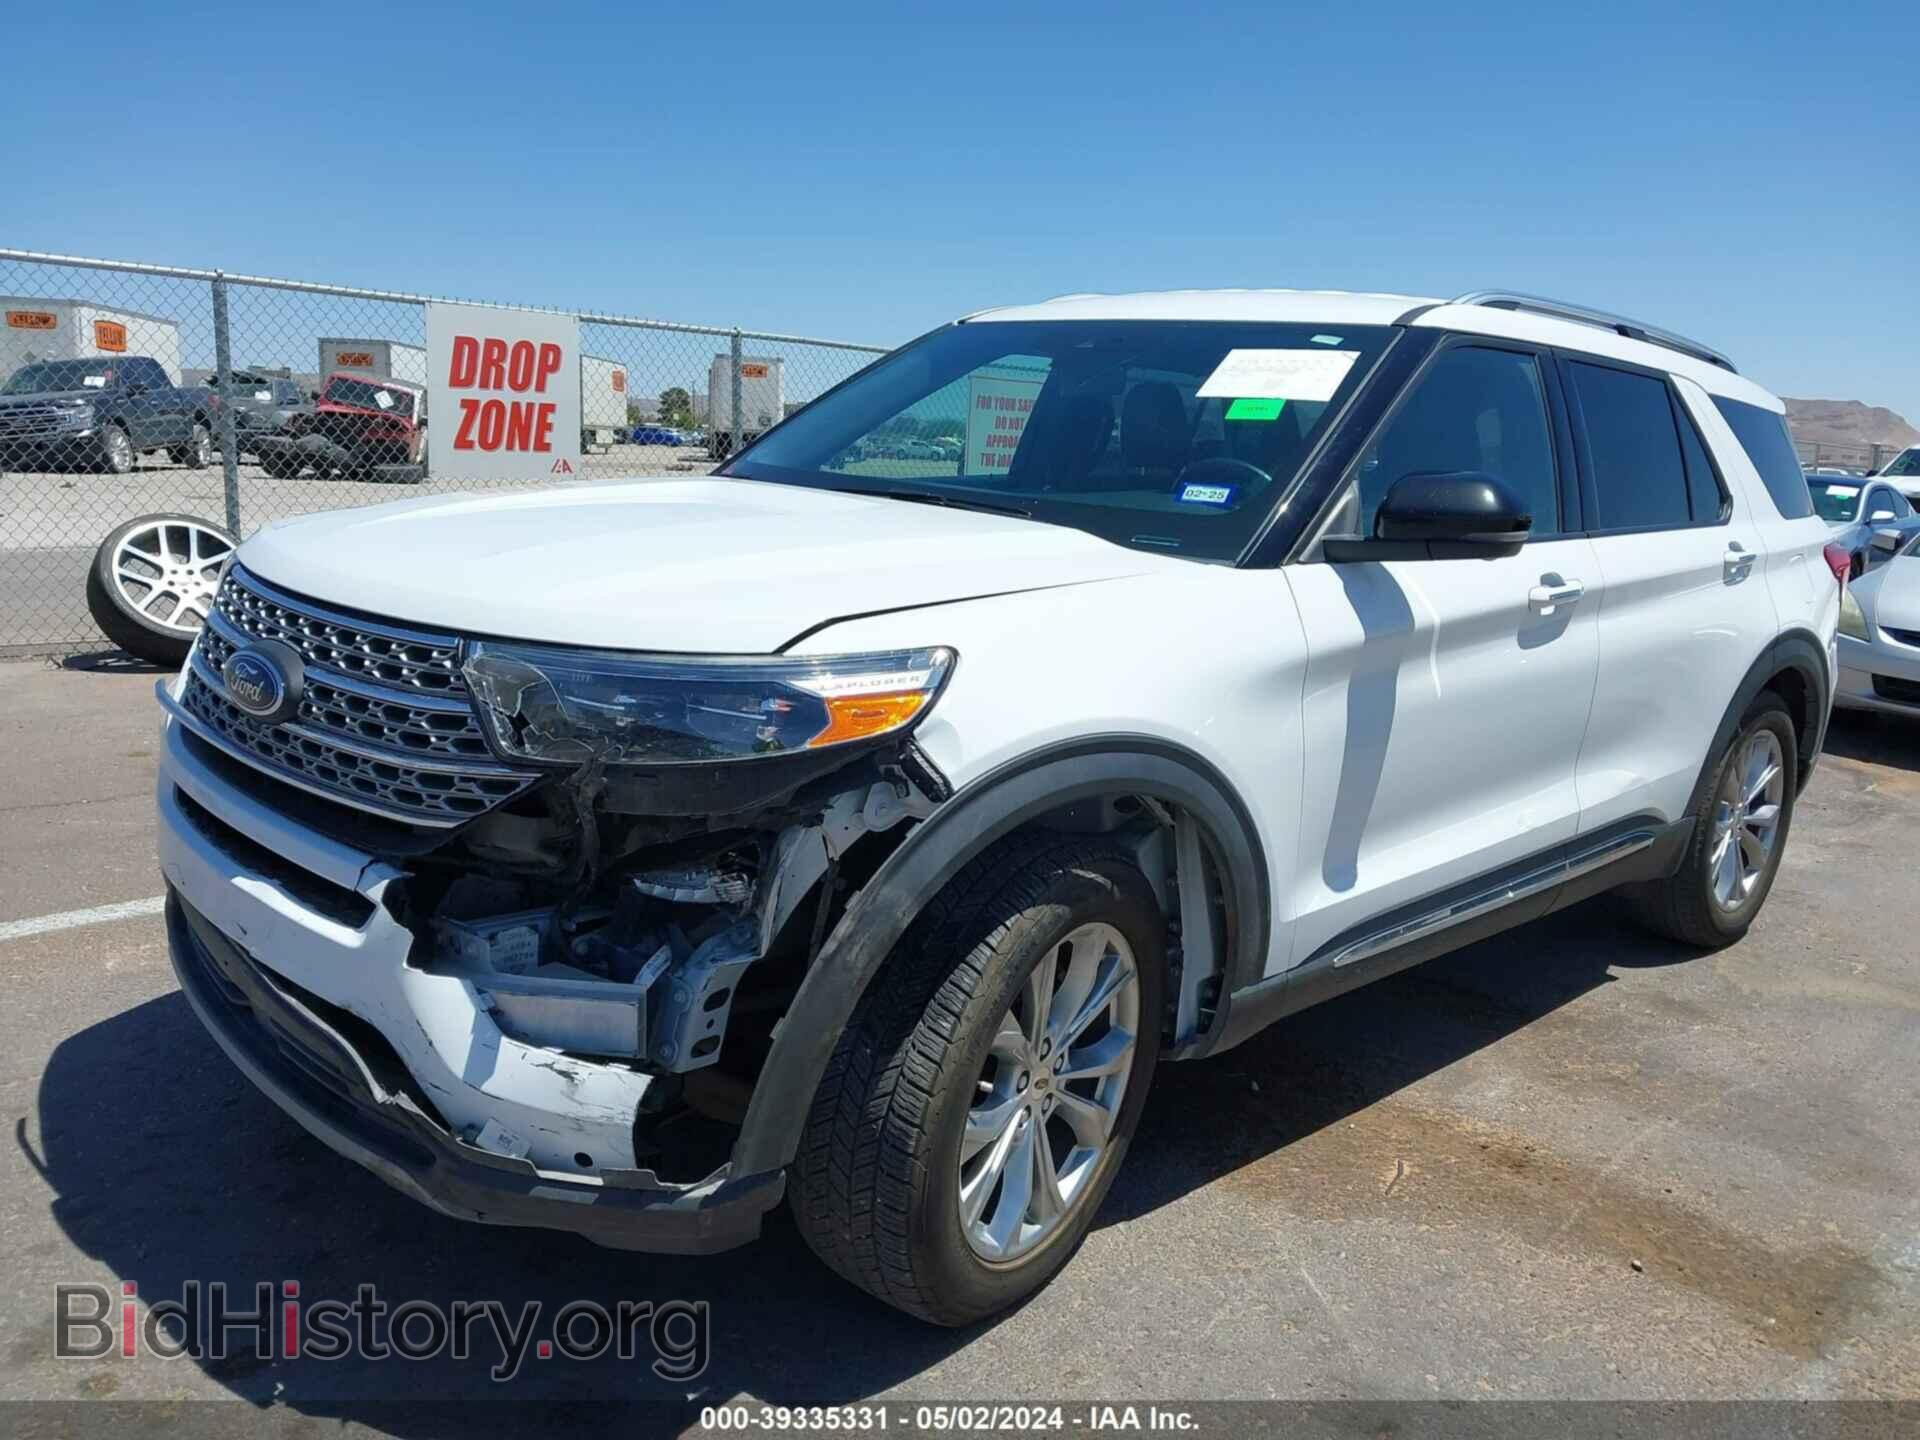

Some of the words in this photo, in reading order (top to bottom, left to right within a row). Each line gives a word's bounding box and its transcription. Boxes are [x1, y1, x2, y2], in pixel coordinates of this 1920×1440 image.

[449, 335, 562, 393] DROP
[976, 394, 993, 410] FOR
[994, 396, 1017, 411] YOUR
[453, 398, 557, 453] ZONE
[995, 416, 1007, 430] DO
[230, 663, 265, 702] Ford
